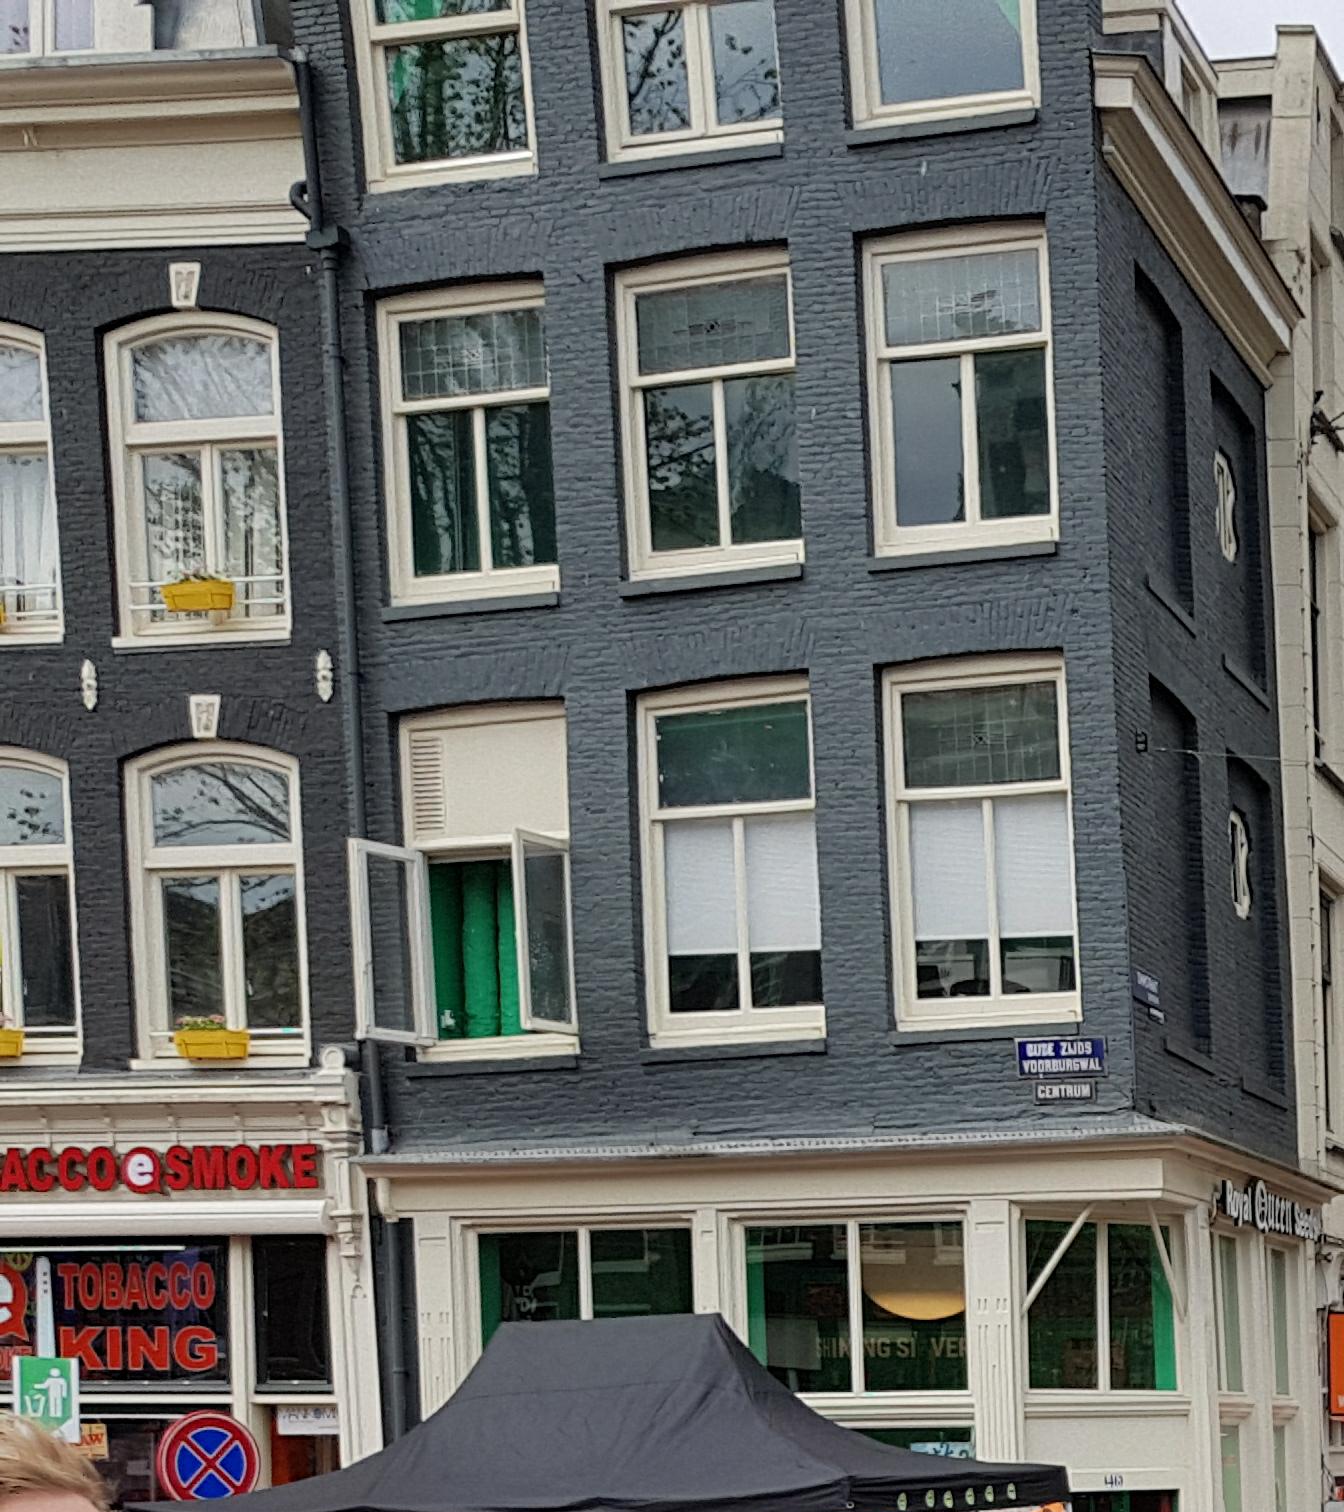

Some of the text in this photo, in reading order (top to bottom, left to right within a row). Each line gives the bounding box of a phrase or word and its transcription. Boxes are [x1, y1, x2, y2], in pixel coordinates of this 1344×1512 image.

[1022, 1058, 1102, 1073] VOORBURGWAL
[1060, 1041, 1092, 1055] ZIJDS
[1037, 1084, 1091, 1098] CENTRUM
[165, 1144, 320, 1191] SMOKE
[1225, 1180, 1252, 1228] Royal
[1255, 1180, 1292, 1235] Queen
[57, 1262, 216, 1310] TOBACCO
[59, 1325, 219, 1371] KING
